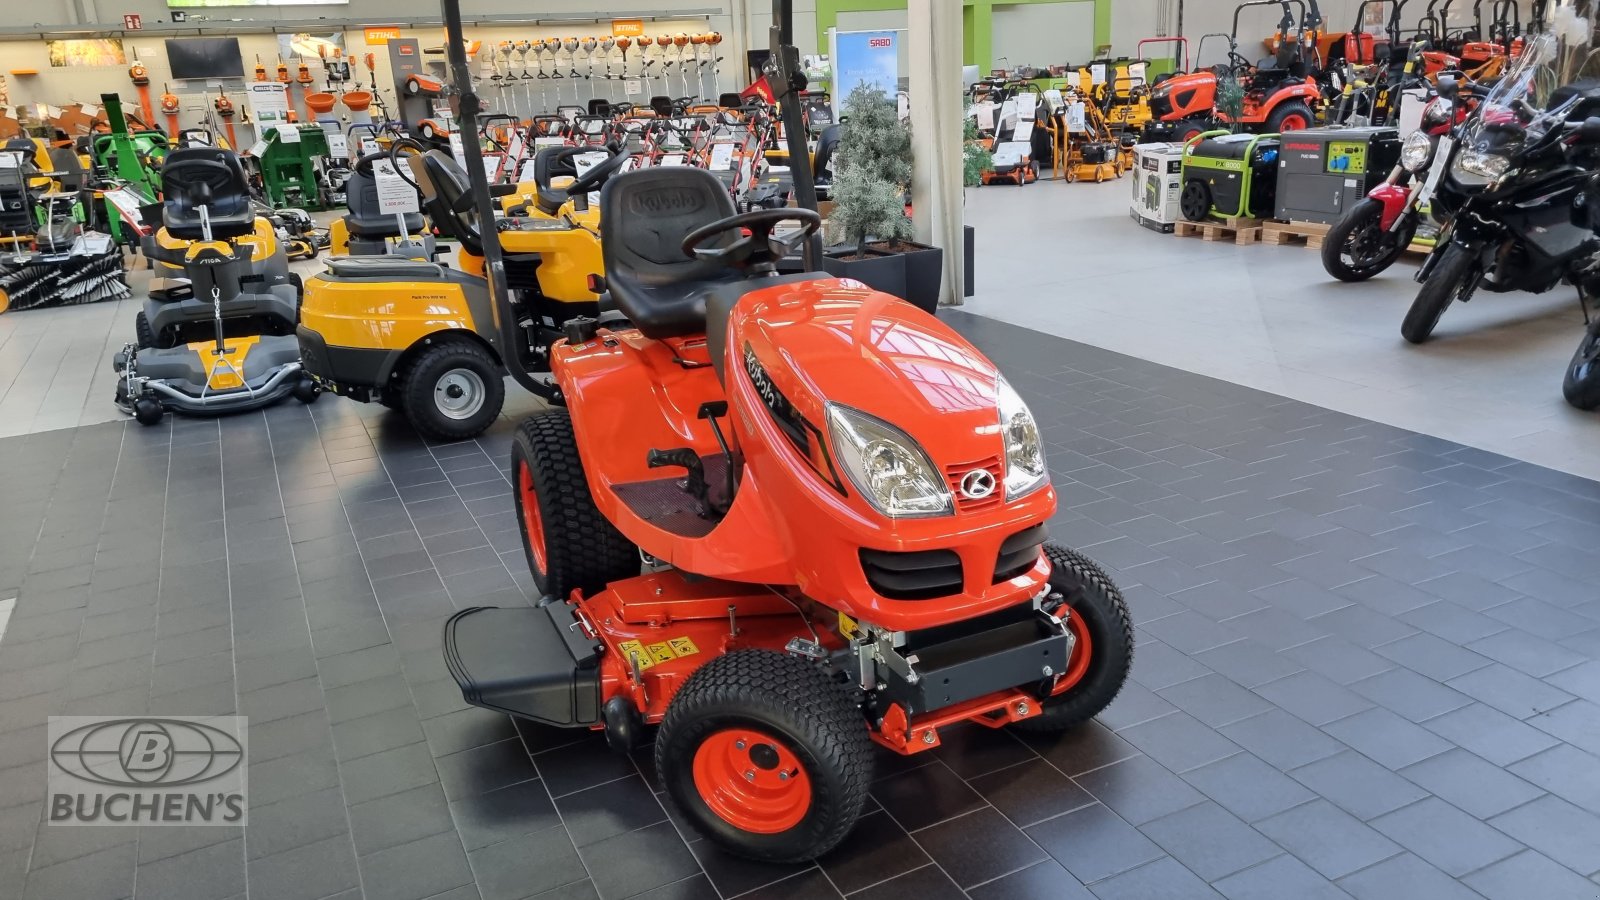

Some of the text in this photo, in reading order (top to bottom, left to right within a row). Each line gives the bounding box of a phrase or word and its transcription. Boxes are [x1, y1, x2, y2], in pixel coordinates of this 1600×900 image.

[615, 24, 640, 32] STIHL
[368, 31, 397, 39] STIHL
[870, 39, 890, 47] SABO
[745, 351, 776, 408] Kubota
